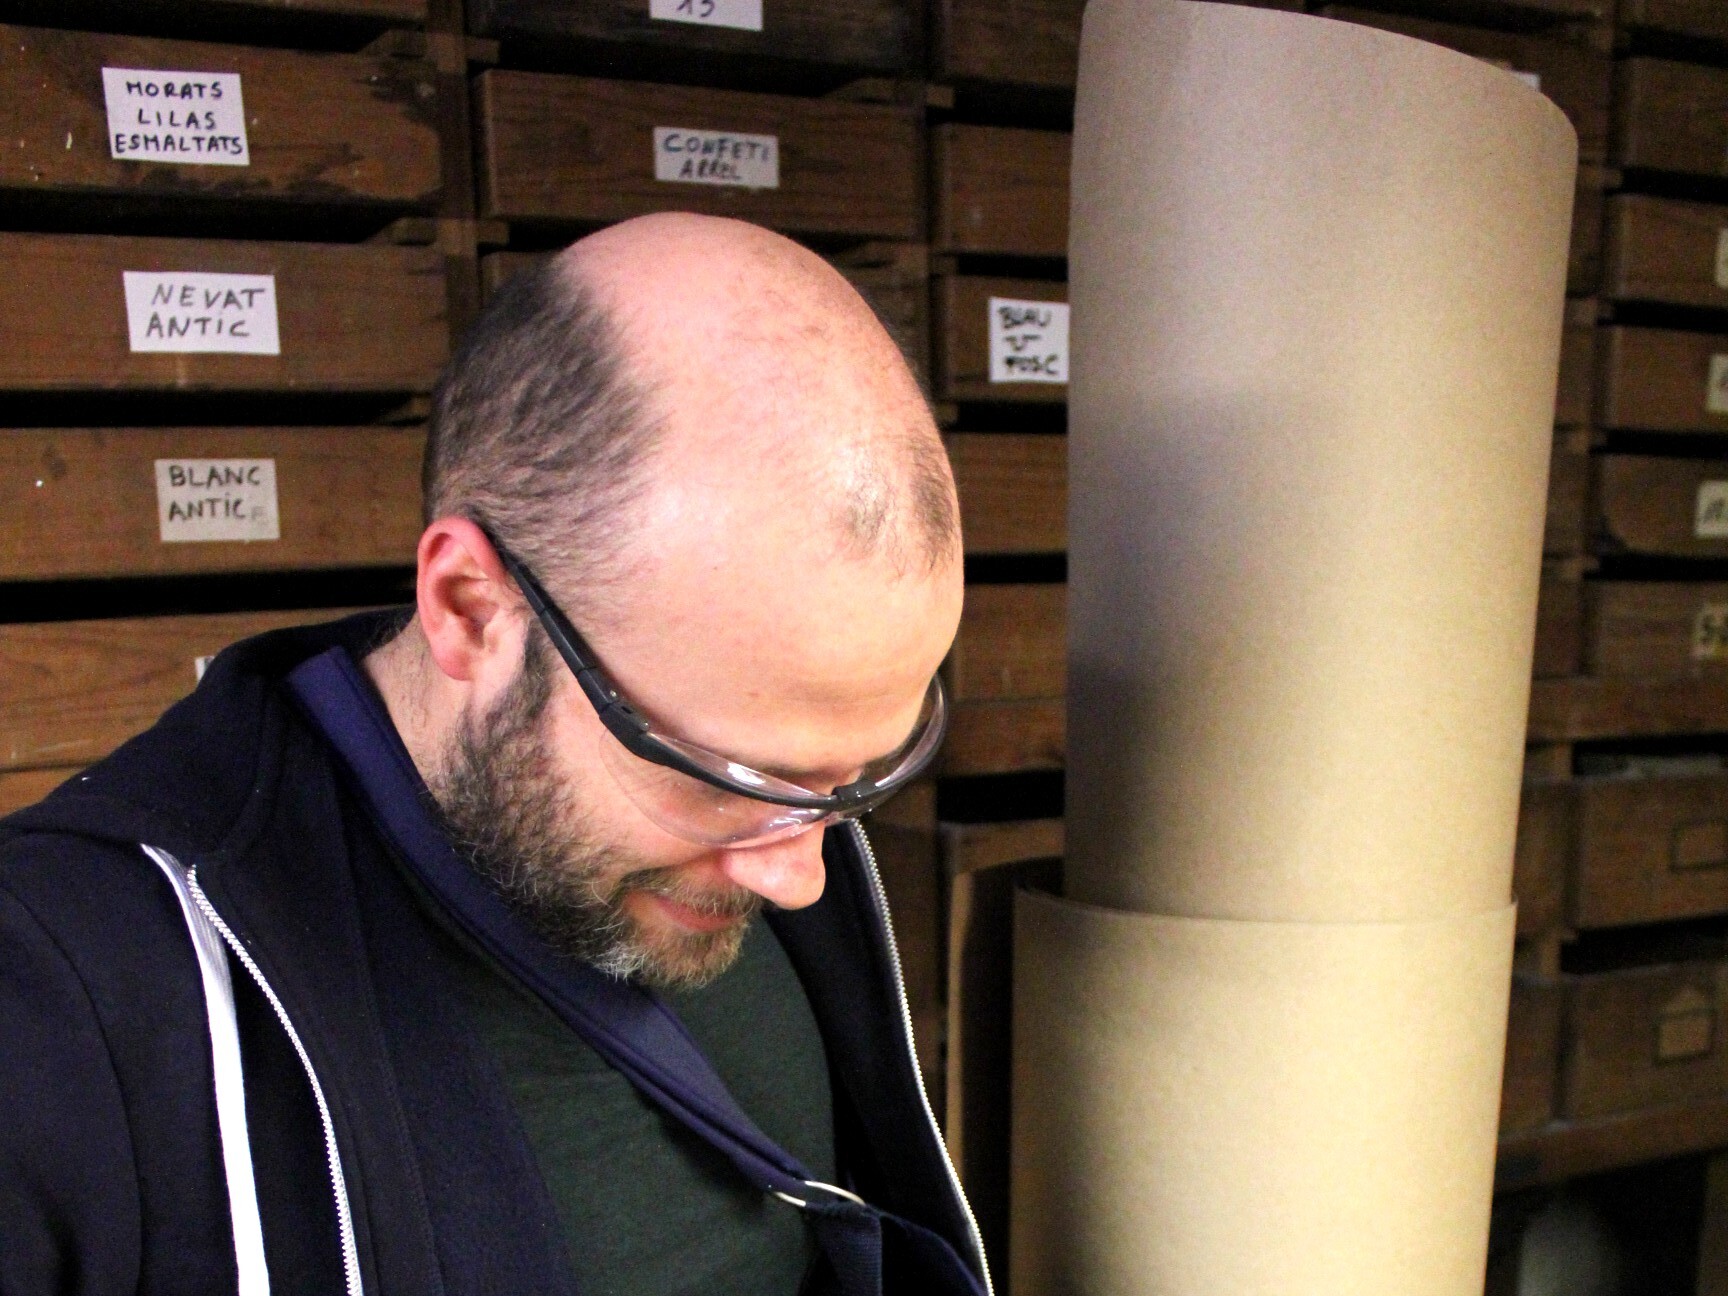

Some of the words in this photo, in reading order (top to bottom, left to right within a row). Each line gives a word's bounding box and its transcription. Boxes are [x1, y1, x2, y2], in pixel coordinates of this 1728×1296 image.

[126, 81, 223, 99] MORATS
[137, 108, 216, 130] LILAS
[115, 133, 243, 154] ESMALTATS
[152, 283, 265, 310] NEVAT
[146, 311, 249, 339] ANTIC
[168, 465, 260, 490] BLANC
